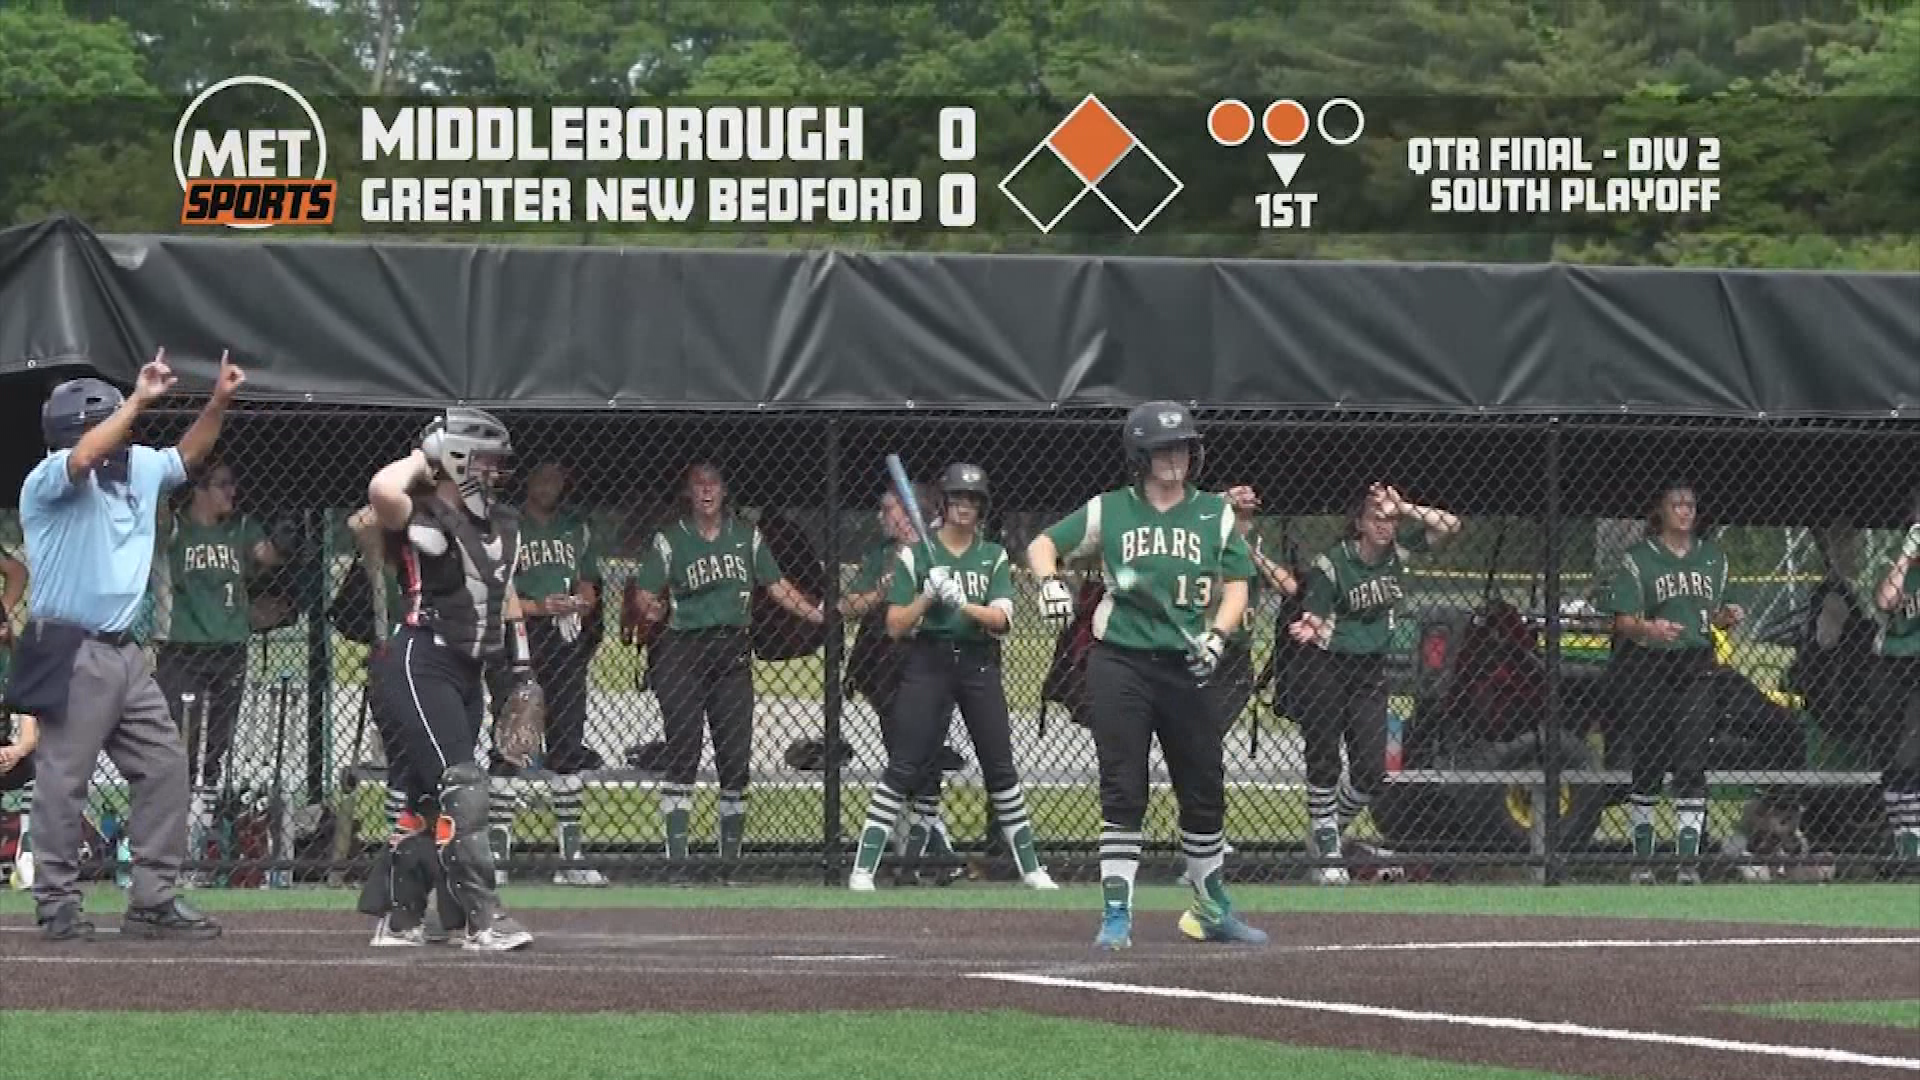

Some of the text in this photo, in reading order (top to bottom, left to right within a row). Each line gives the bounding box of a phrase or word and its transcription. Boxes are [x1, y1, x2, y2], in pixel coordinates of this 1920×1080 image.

[184, 543, 240, 575] BEARS
[520, 539, 576, 571] BEARS
[1121, 525, 1201, 564] BEARS
[686, 554, 748, 590] BEARS
[1656, 571, 1713, 603] BEARS
[739, 591, 751, 615] 7
[1174, 575, 1212, 607] 13
